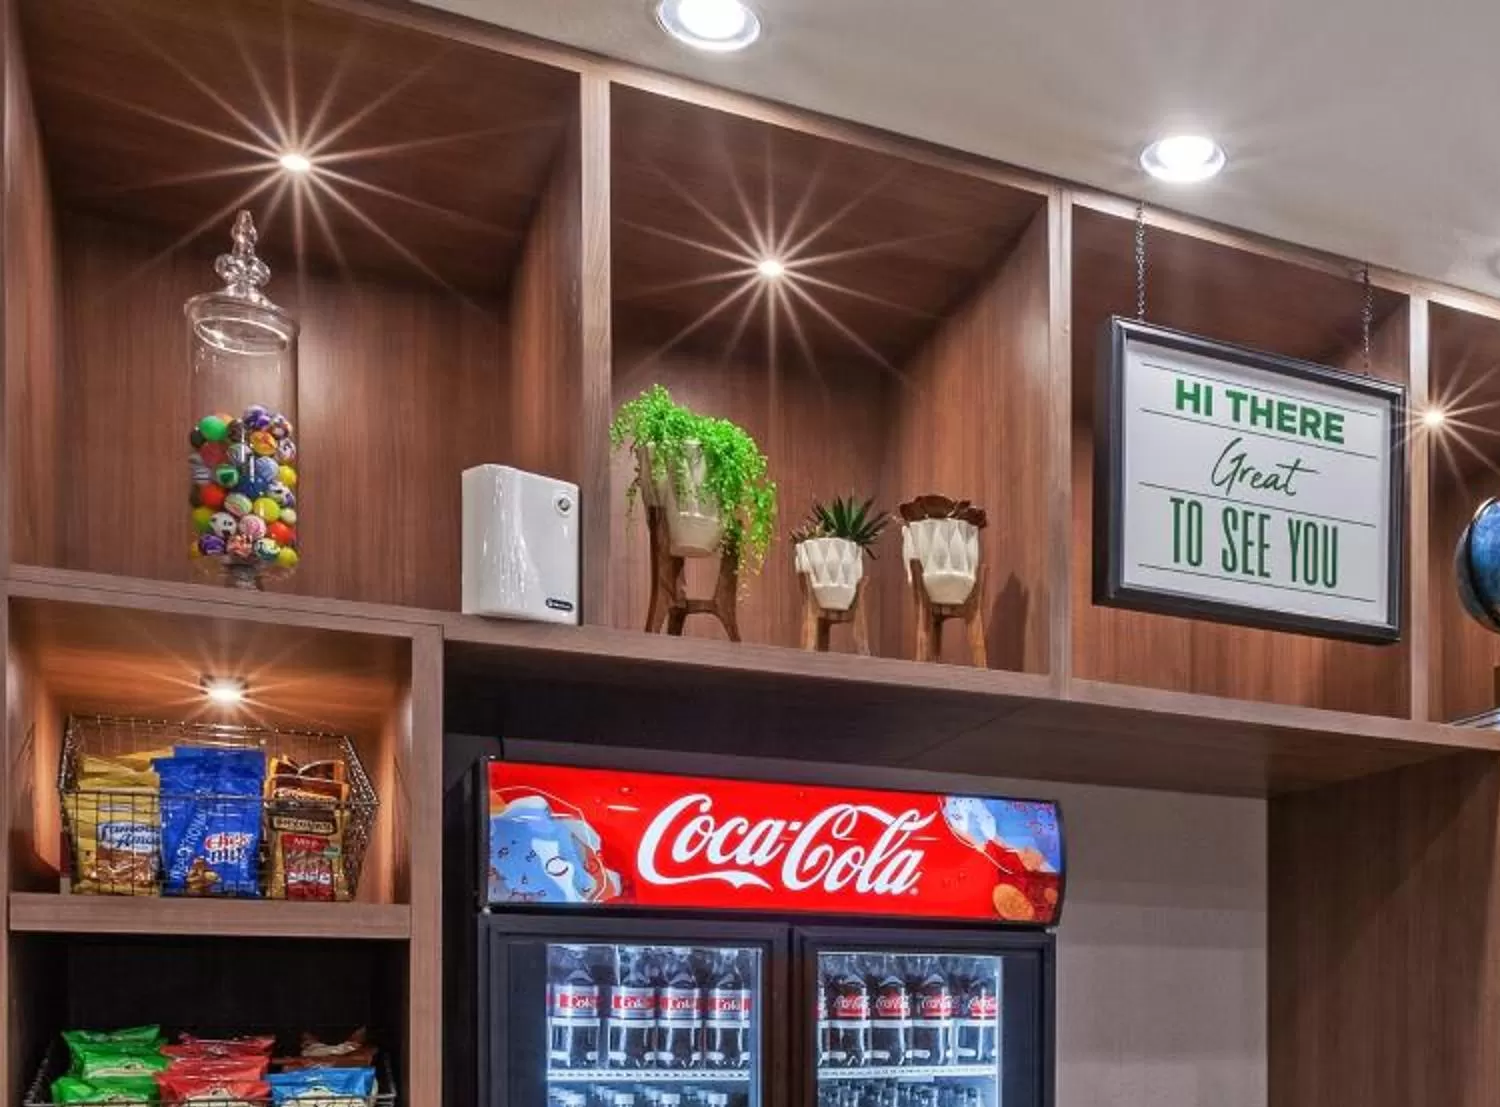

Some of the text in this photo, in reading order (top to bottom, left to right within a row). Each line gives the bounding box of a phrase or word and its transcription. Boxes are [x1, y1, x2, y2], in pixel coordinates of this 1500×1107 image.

[1175, 378, 1345, 444] HI THERE
[1210, 437, 1321, 496] Great
[1169, 496, 1339, 589] TO SEE YOU
[100, 824, 159, 841] Famou
[637, 792, 938, 896] Coca-Cola
